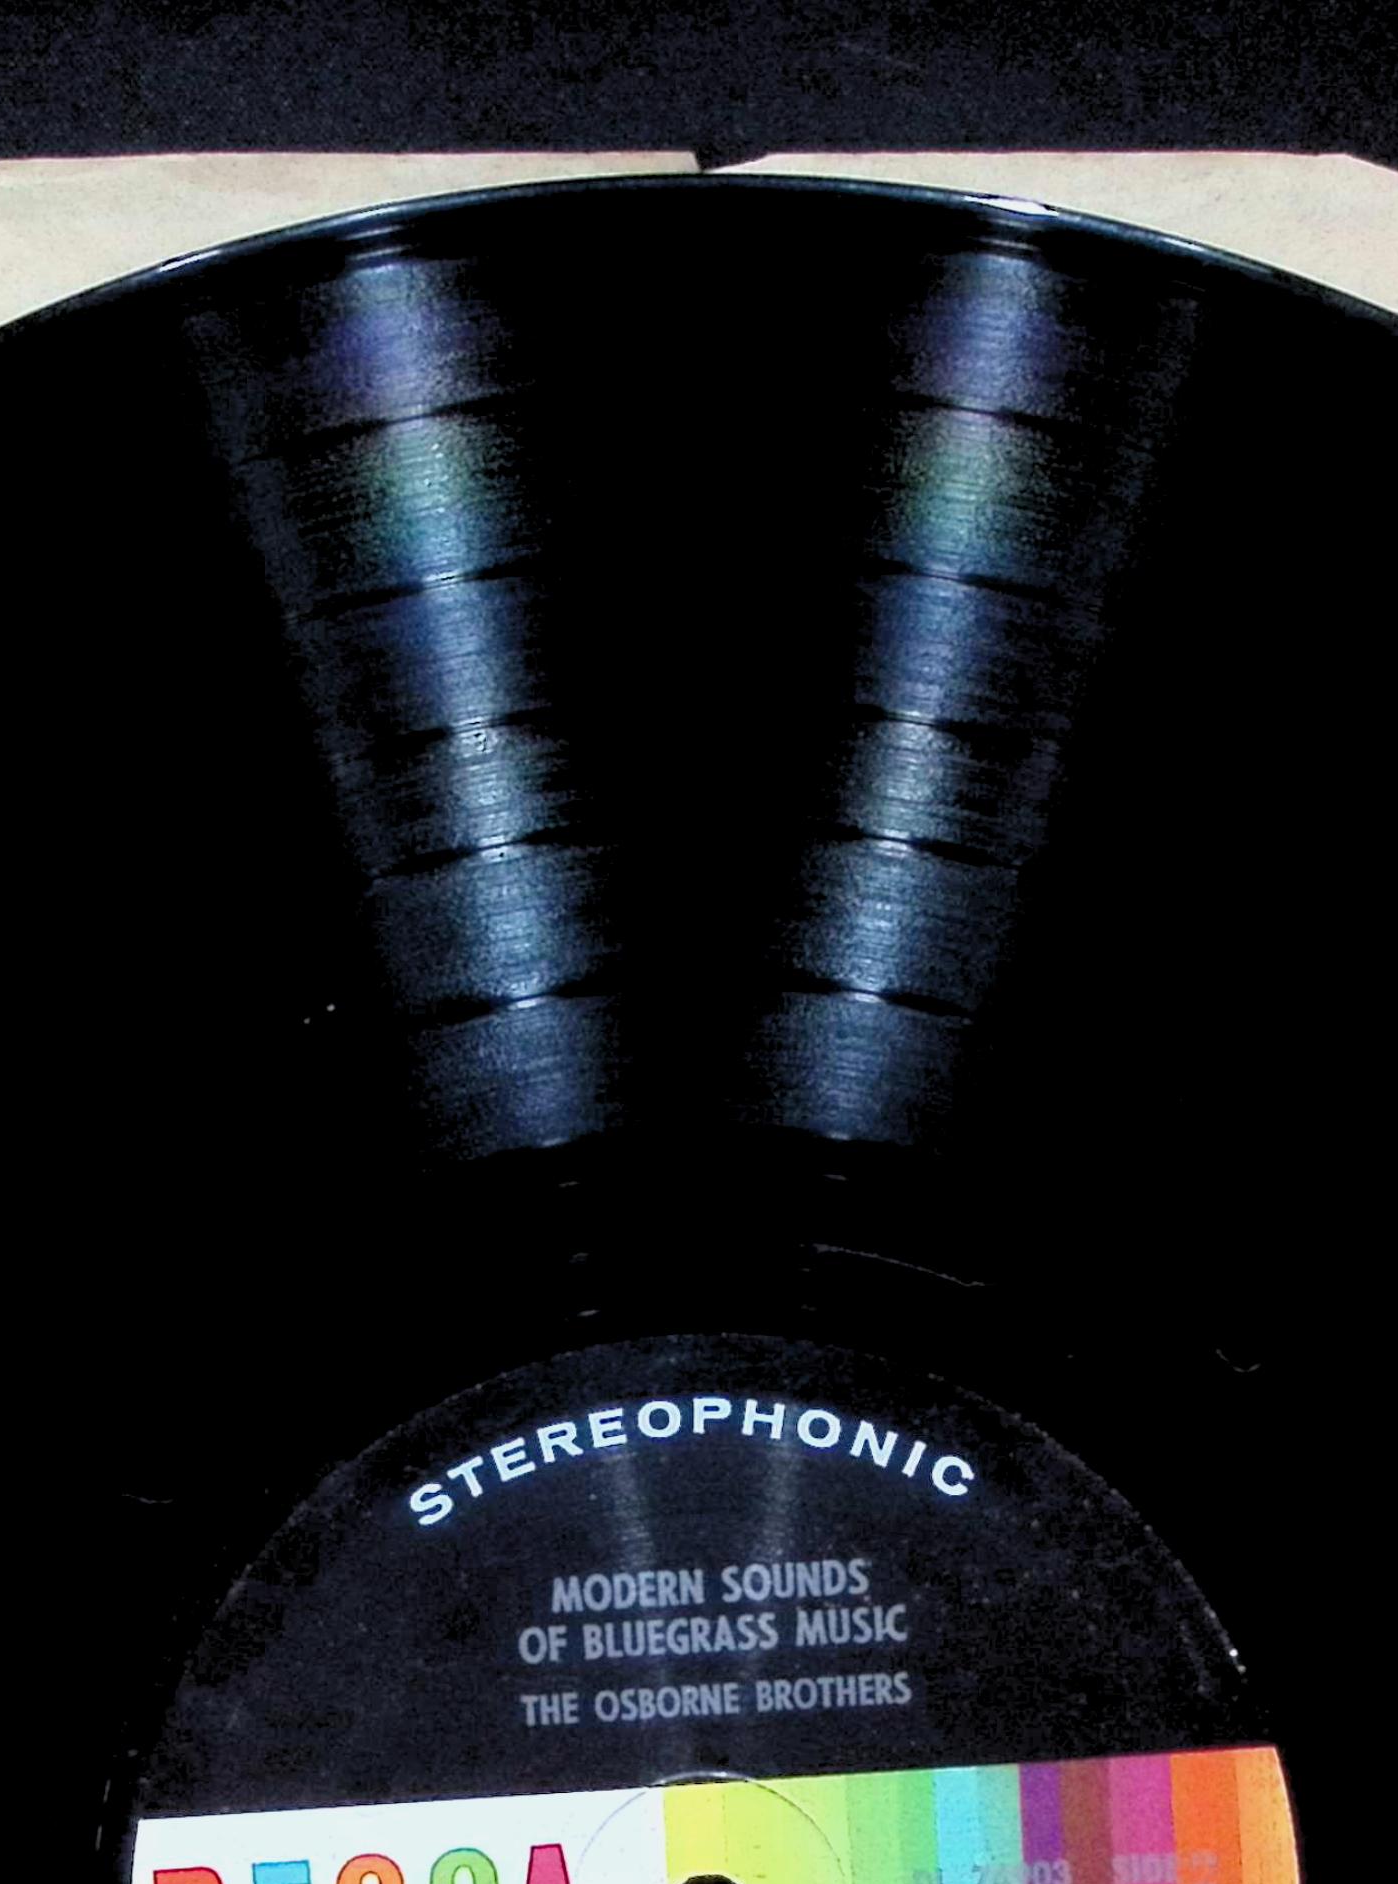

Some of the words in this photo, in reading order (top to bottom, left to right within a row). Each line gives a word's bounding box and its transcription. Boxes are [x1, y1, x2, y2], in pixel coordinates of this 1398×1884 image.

[409, 1396, 976, 1527] STEREOPHONIC
[551, 1568, 704, 1614] MODERN
[721, 1558, 869, 1602] SOUNDS
[518, 1625, 568, 1665] OF
[583, 1613, 779, 1660] BLUEGRASS
[795, 1605, 908, 1648] MUSIC
[520, 1692, 581, 1727] THE
[594, 1683, 741, 1722] OSBORNE
[756, 1672, 913, 1713] BROTHERS
